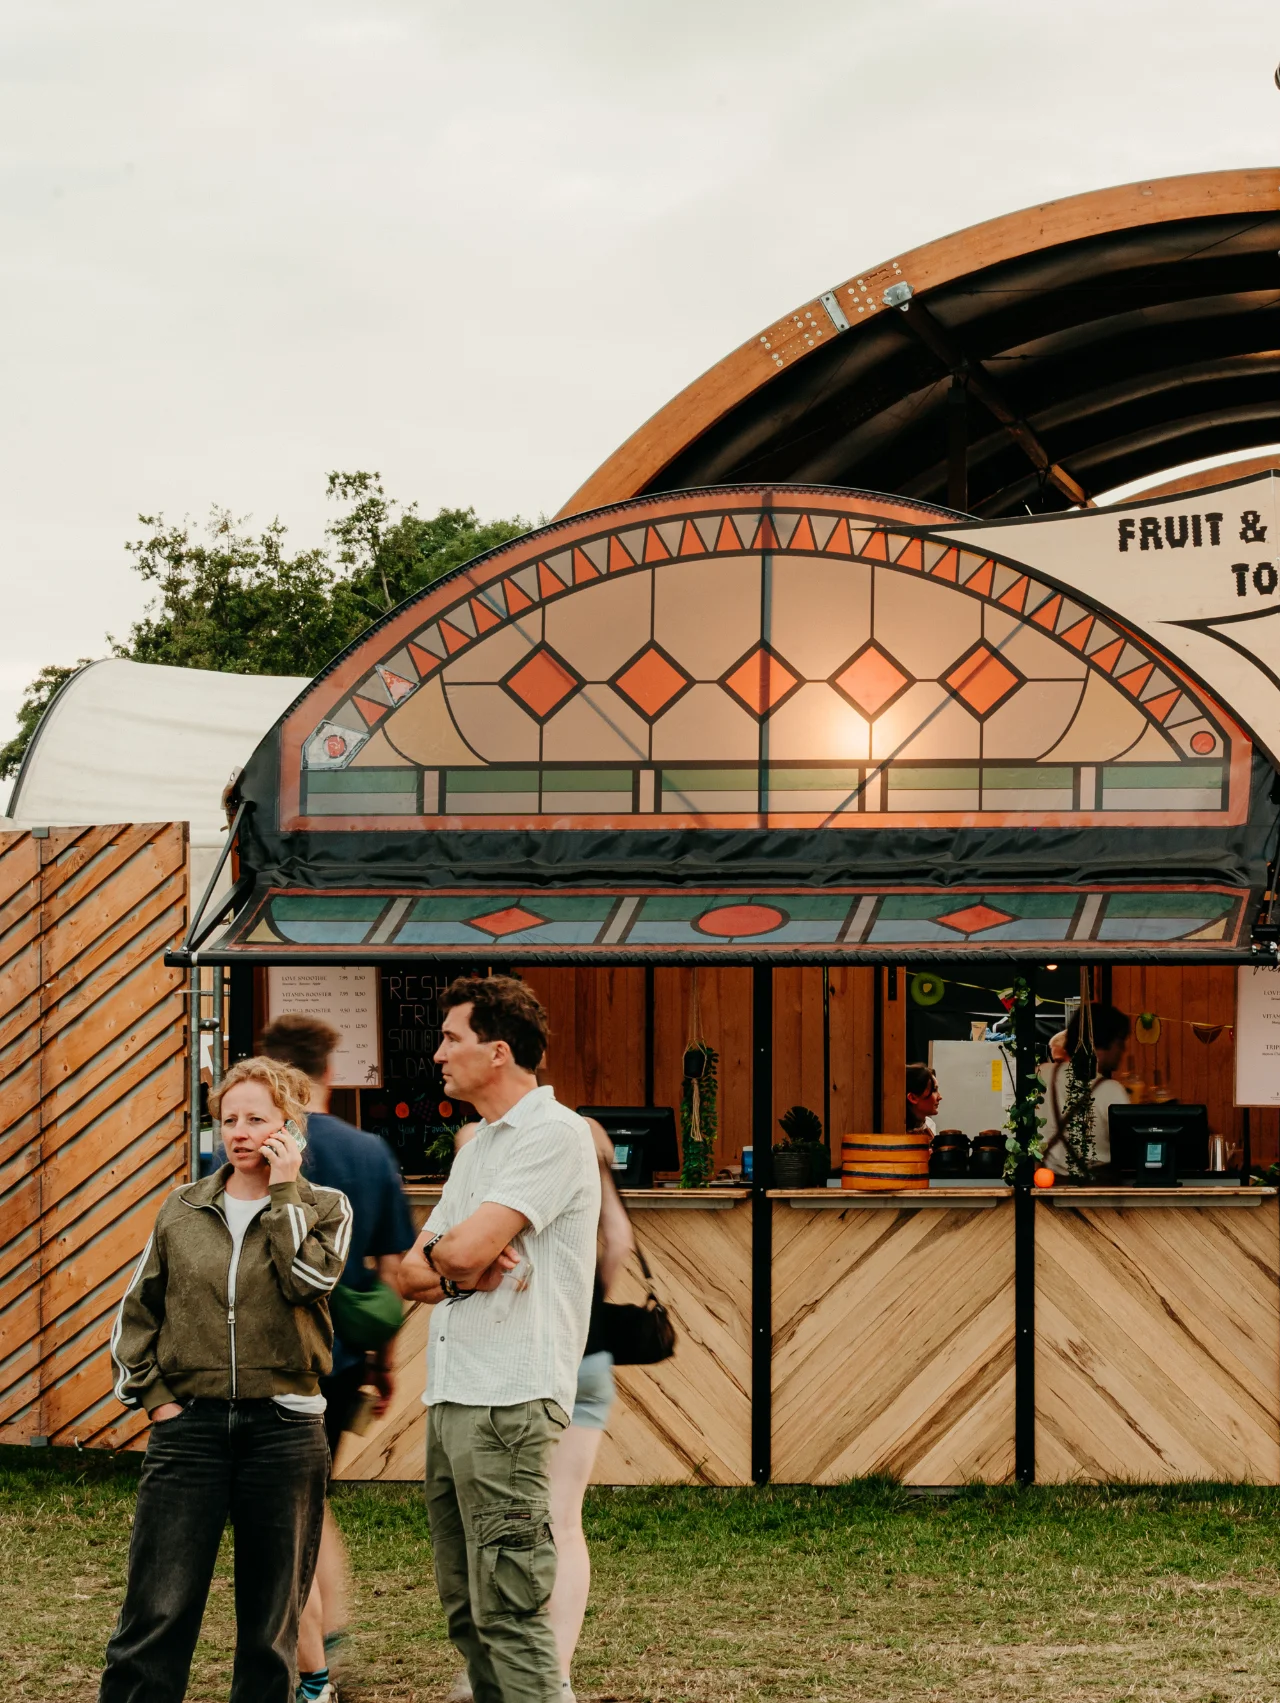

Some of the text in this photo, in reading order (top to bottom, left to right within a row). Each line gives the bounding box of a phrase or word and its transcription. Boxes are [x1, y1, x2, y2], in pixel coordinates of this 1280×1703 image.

[1118, 512, 1224, 553] FRUIT
[1239, 510, 1268, 544] &
[399, 1004, 446, 1026] FRU
[405, 1056, 437, 1079] DAY
